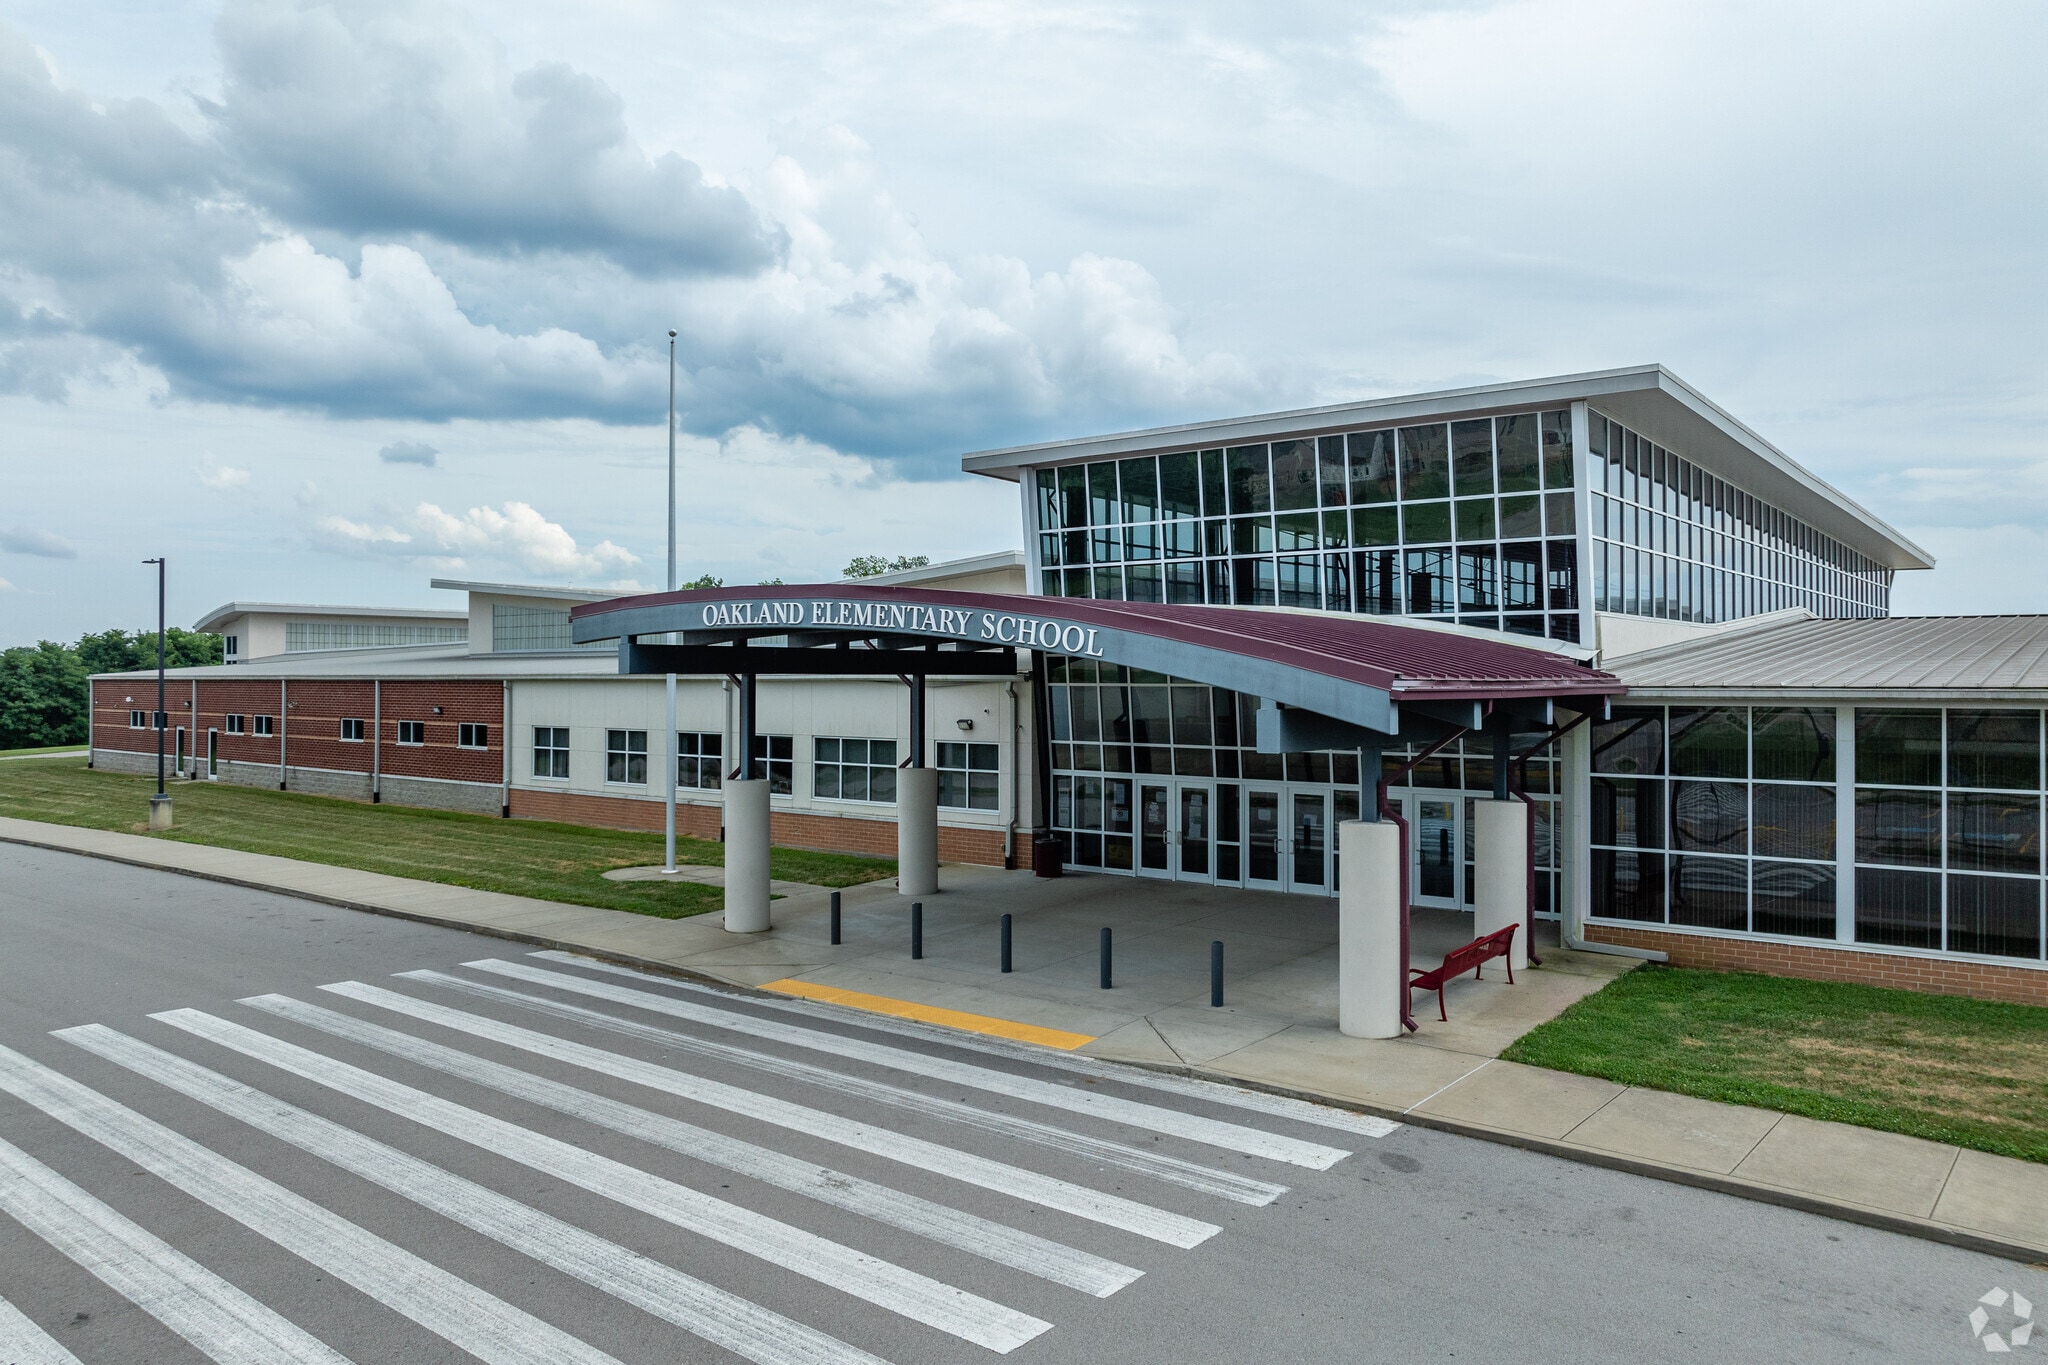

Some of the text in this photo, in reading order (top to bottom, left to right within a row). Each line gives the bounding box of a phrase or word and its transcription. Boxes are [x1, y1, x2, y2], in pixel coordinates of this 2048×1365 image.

[702, 601, 1104, 657] OAKLAND ELEMENTARY SCHOOL
